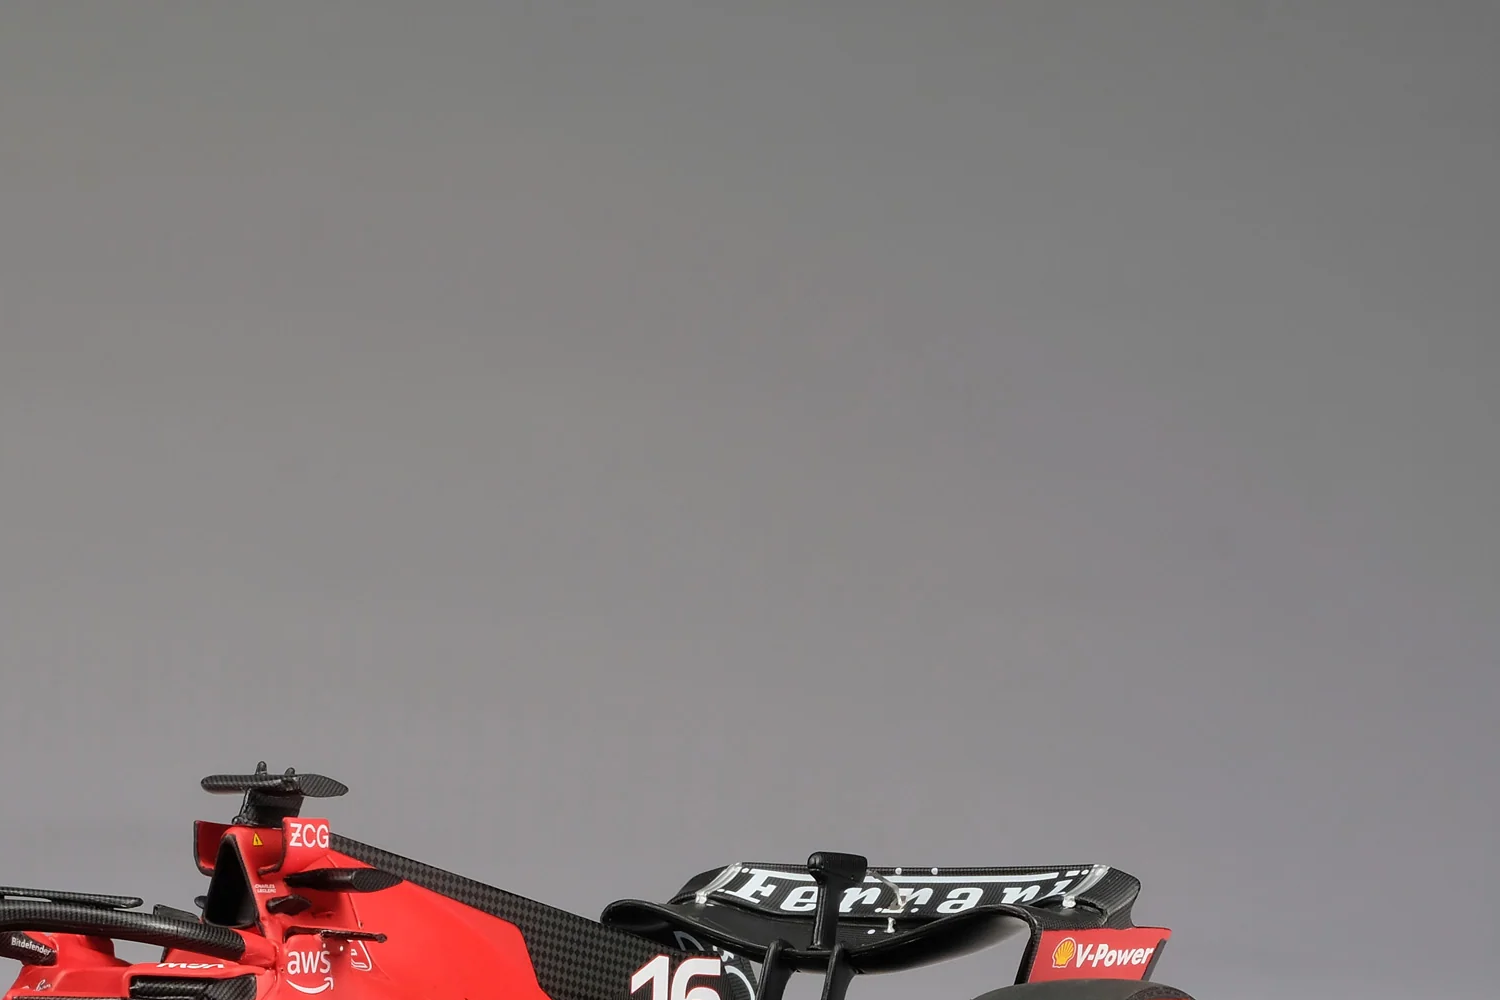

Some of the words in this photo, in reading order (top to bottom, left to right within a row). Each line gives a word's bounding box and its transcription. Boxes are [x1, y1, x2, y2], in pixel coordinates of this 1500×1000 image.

[726, 868, 1090, 916] Ferrari
[11, 937, 52, 956] Bitdefender
[1075, 943, 1155, 969] V-Power
[287, 950, 331, 975] aws
